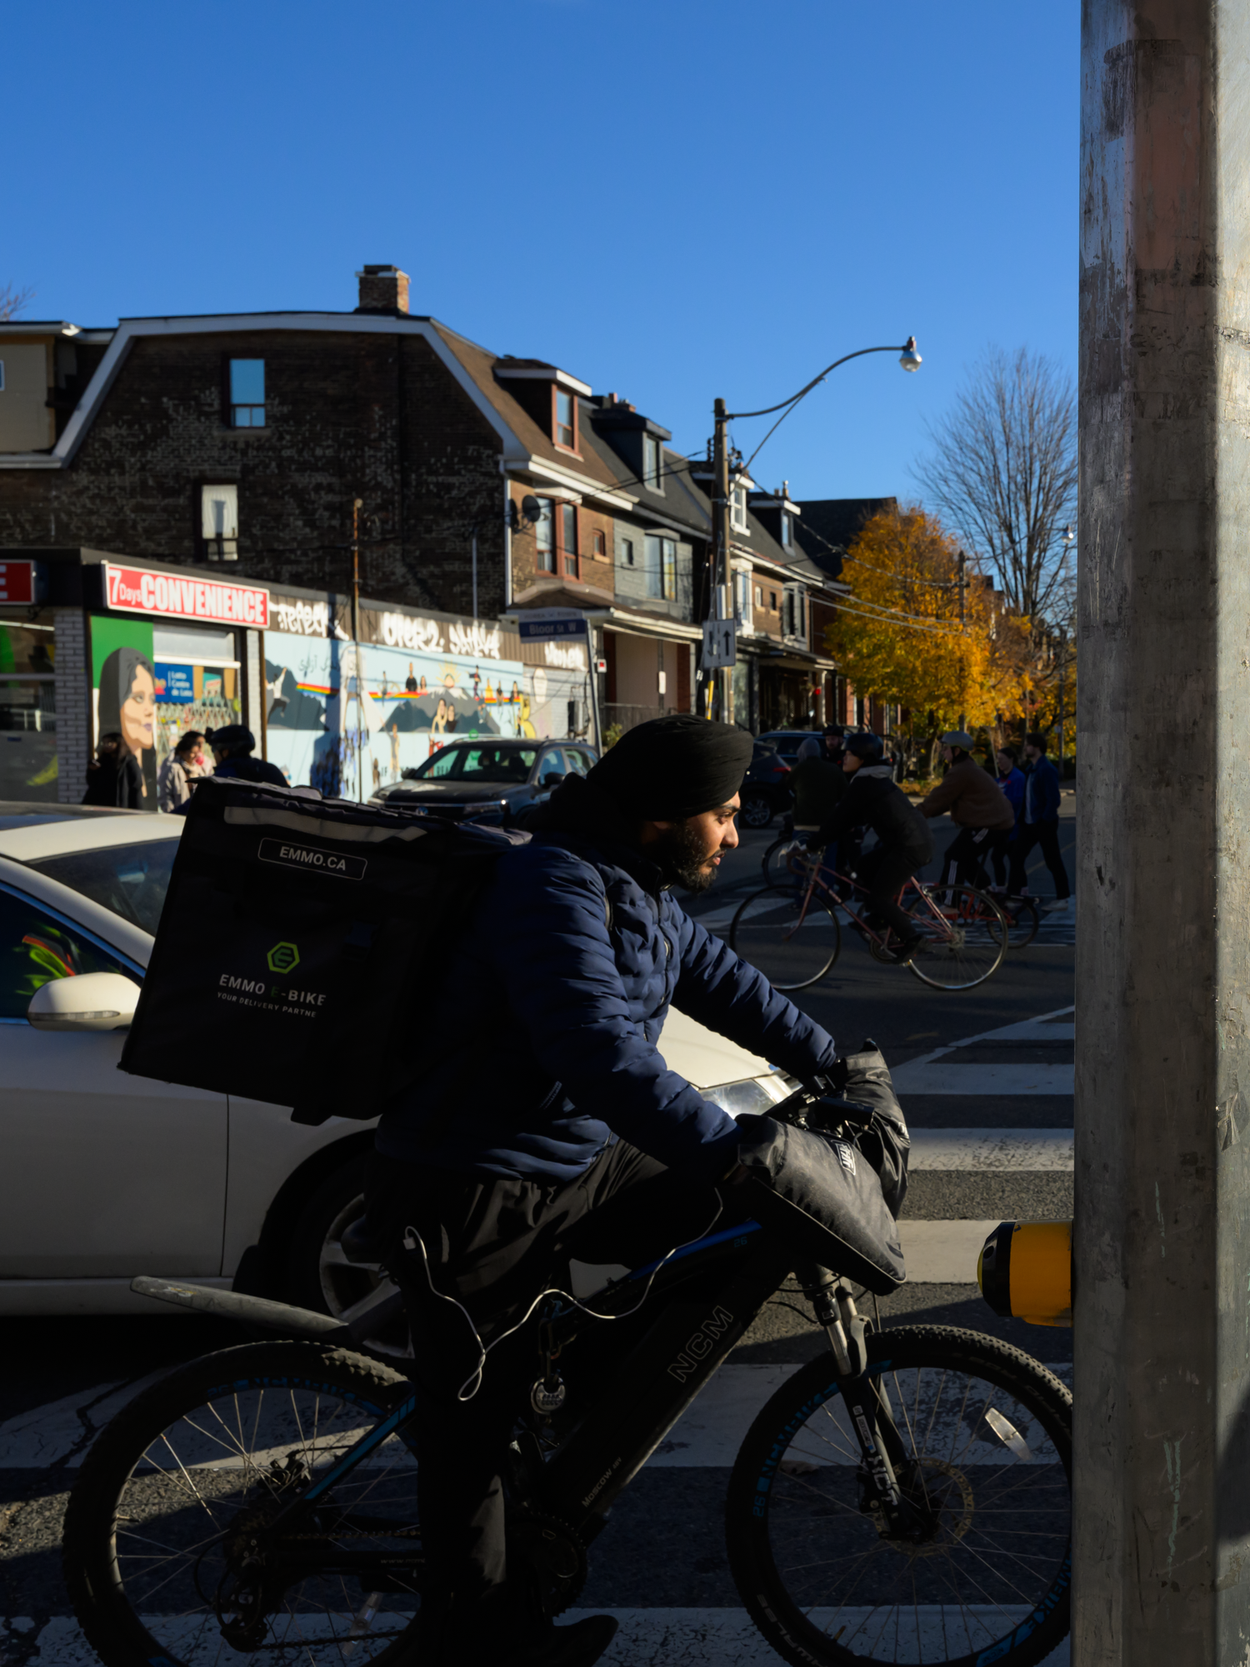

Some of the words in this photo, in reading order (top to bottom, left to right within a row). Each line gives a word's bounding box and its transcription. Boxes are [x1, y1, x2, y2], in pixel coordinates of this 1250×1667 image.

[108, 569, 122, 603] 7
[120, 583, 142, 606] Days
[140, 574, 265, 624] CONVENIENCE
[529, 624, 555, 635] Bloor
[568, 622, 576, 632] W
[279, 846, 346, 871] EMMO.CA
[219, 974, 266, 995] EMMO
[270, 986, 326, 1006] E-BIKE
[217, 992, 237, 1002] YOUR
[239, 997, 279, 1011] DELIVERY
[282, 1006, 317, 1018] PARTNE
[666, 1304, 734, 1384] NCM
[752, 1495, 766, 1518] 26
